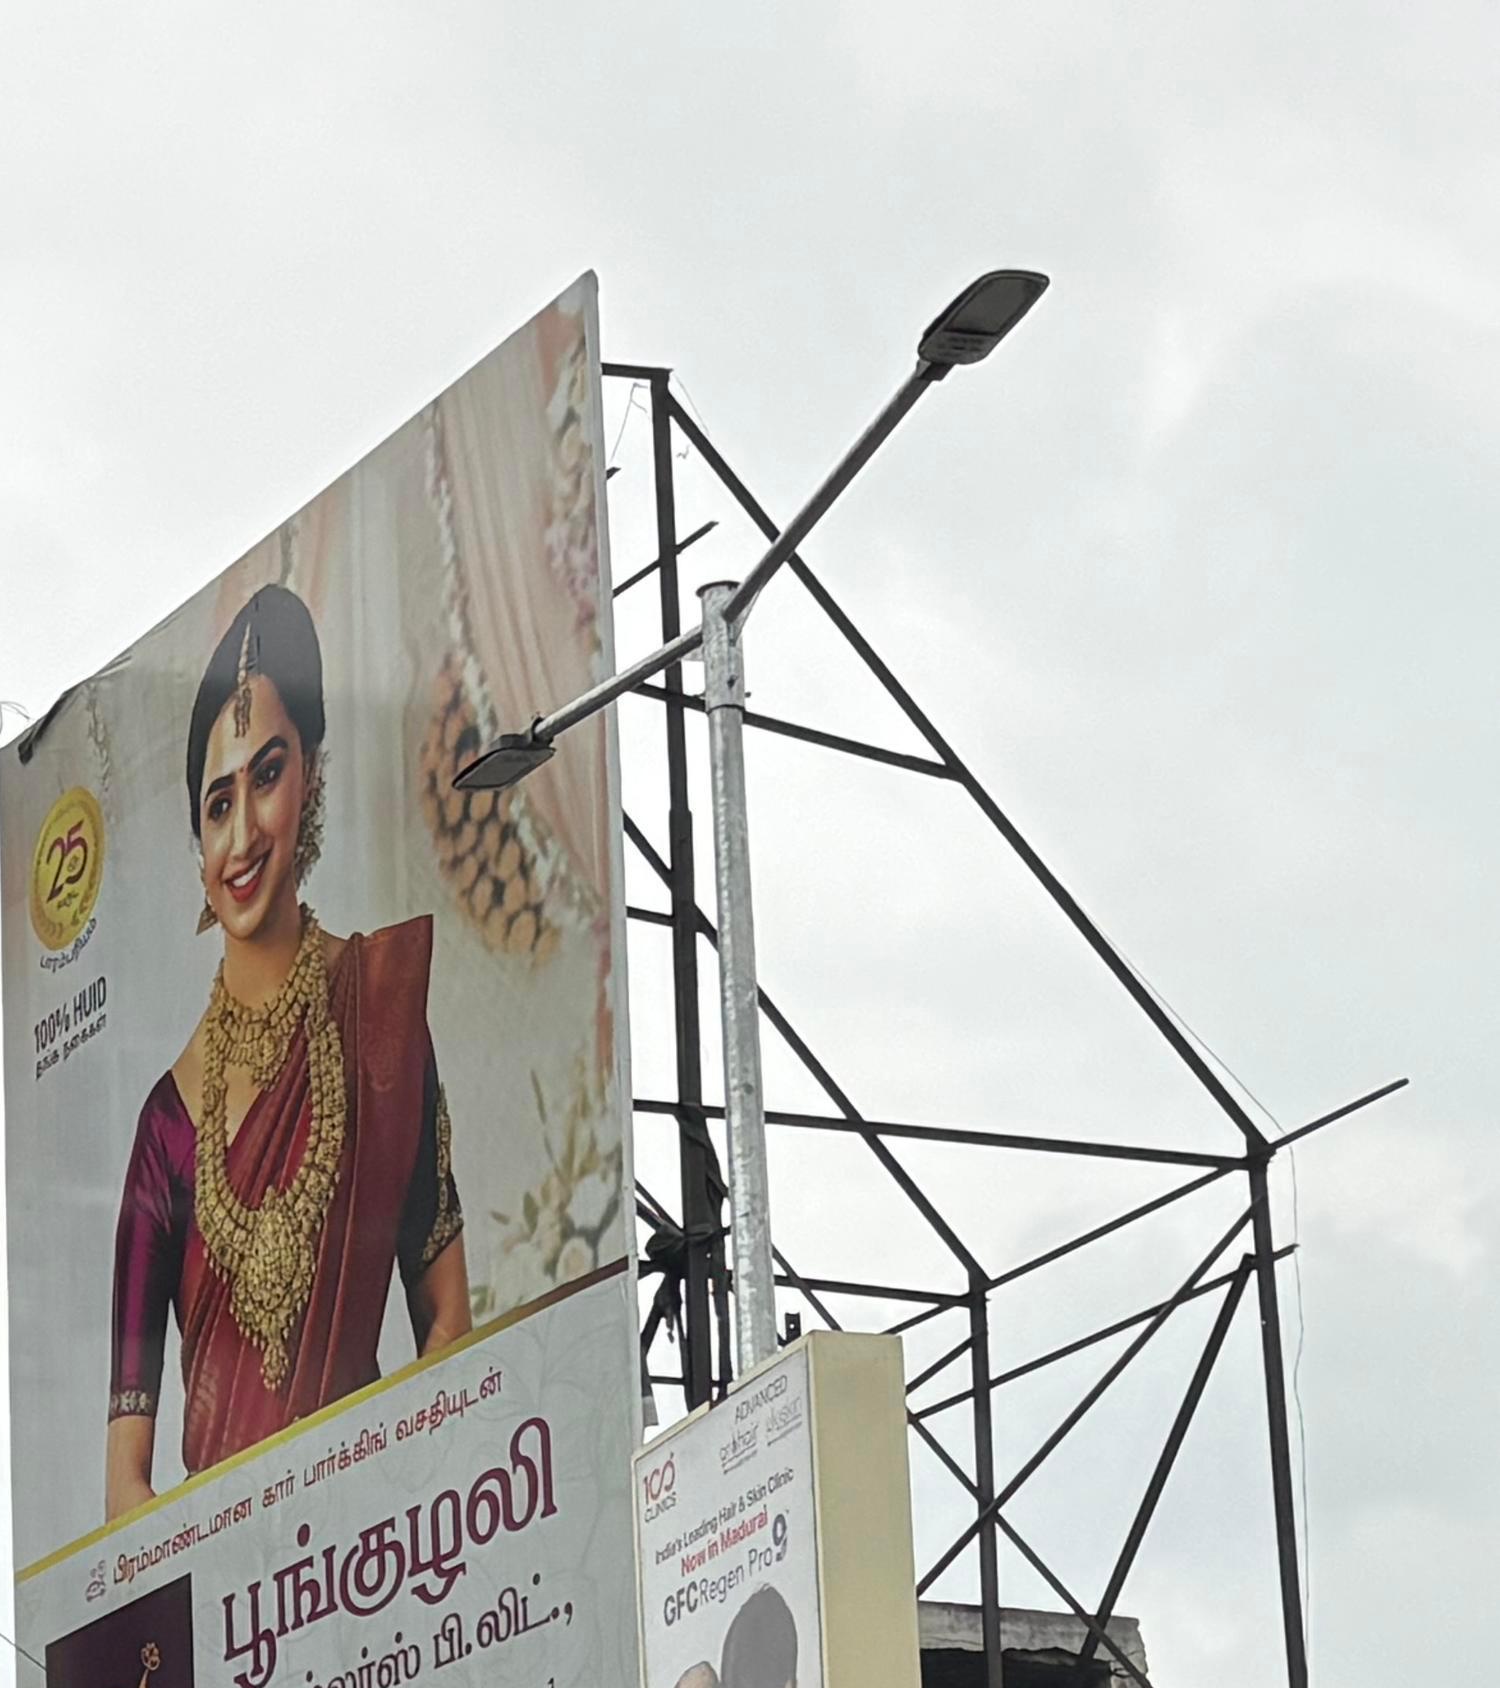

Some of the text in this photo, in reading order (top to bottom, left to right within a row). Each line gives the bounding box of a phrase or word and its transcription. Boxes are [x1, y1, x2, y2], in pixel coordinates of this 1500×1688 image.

[73, 976, 107, 1026] HUID
[734, 1374, 789, 1423] ADVANCED
[112, 1365, 503, 1586] பிரம்மாண்டமான கார் பார்க்கிங் வசதியுடன்
[644, 1491, 678, 1524] CLINICS
[682, 1515, 718, 1548] Leading
[717, 1503, 737, 1527] Hair
[746, 1484, 767, 1508] Skin
[767, 1466, 795, 1495] Clinic
[680, 1503, 769, 1578] Now in Madurai
